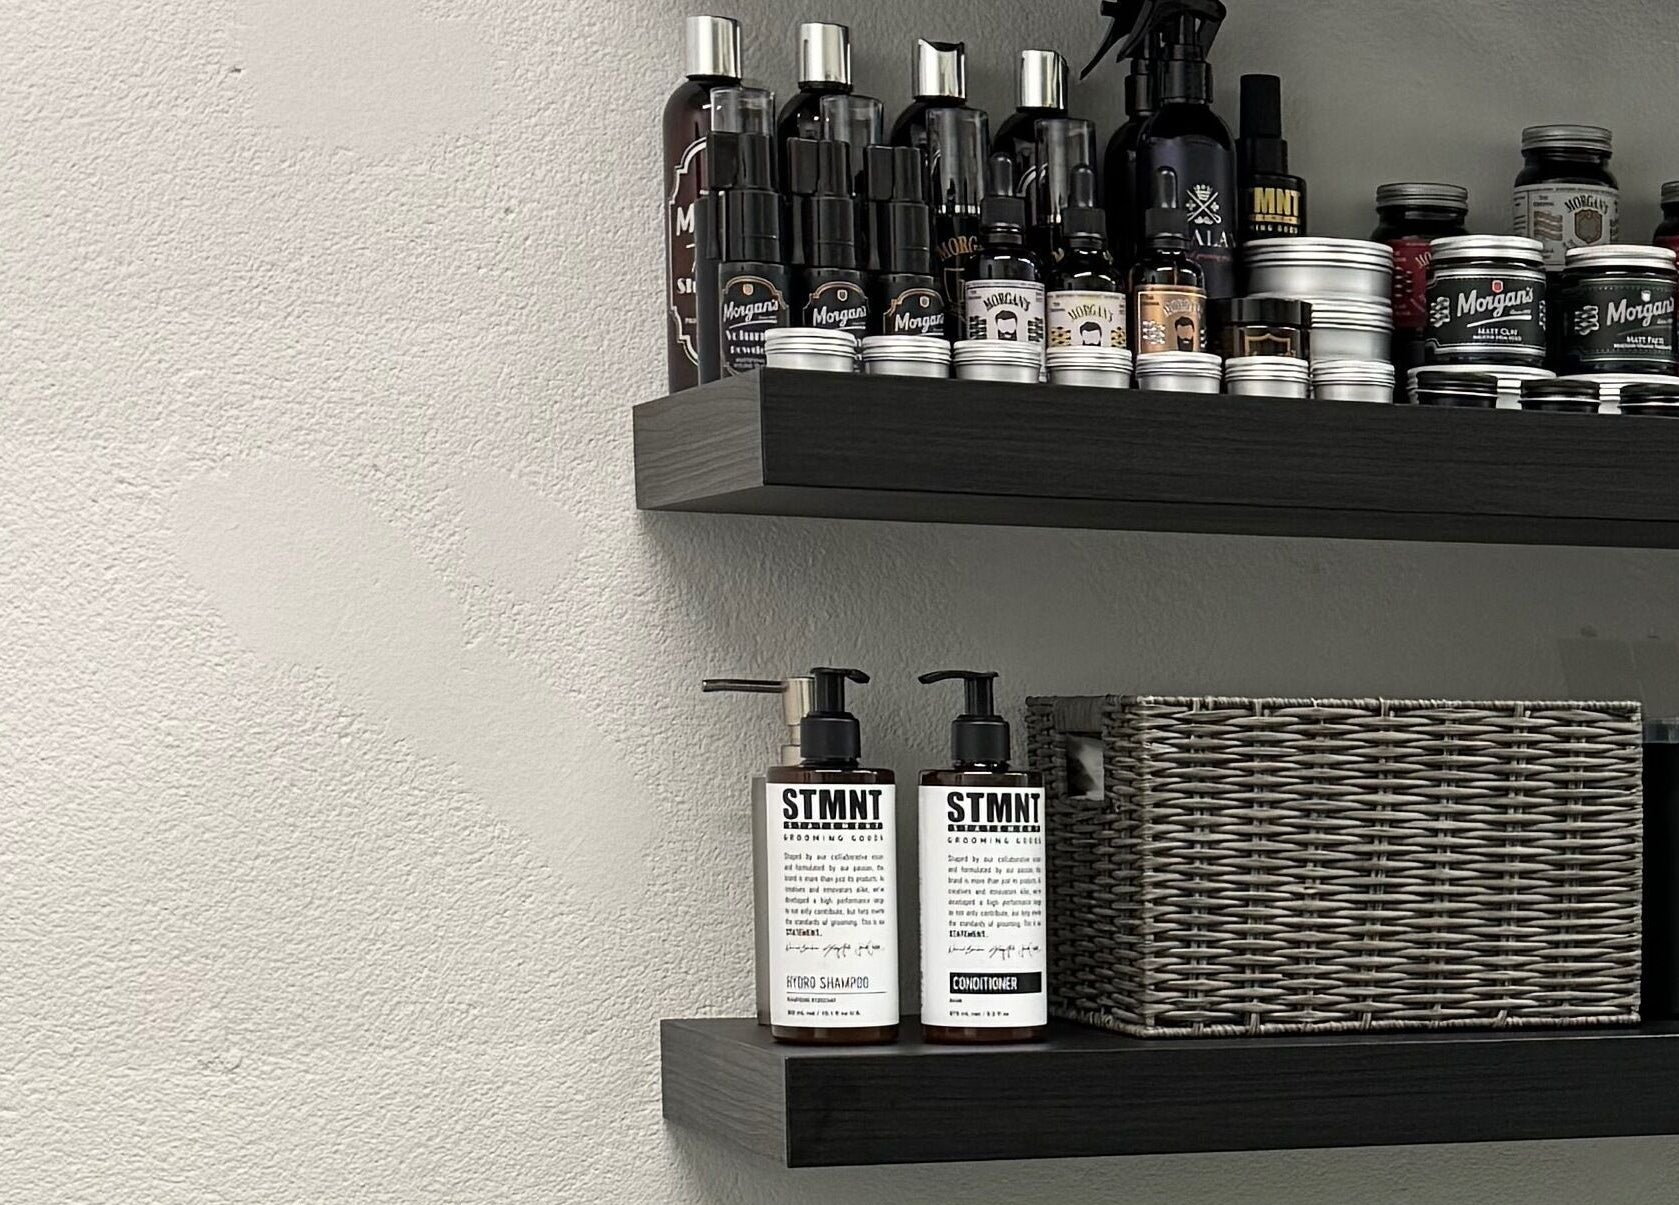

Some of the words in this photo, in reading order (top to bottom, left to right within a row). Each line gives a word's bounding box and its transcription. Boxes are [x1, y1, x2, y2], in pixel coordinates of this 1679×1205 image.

[1250, 187, 1300, 217] MNT
[723, 299, 780, 323] Morgan's
[1456, 286, 1534, 317] Morgan's
[782, 788, 882, 820] STMNT
[947, 791, 1040, 823] STMNT
[786, 975, 816, 989] HYDRO
[819, 975, 869, 989] SHAMPOO
[952, 976, 1018, 991] CONDITIONER
